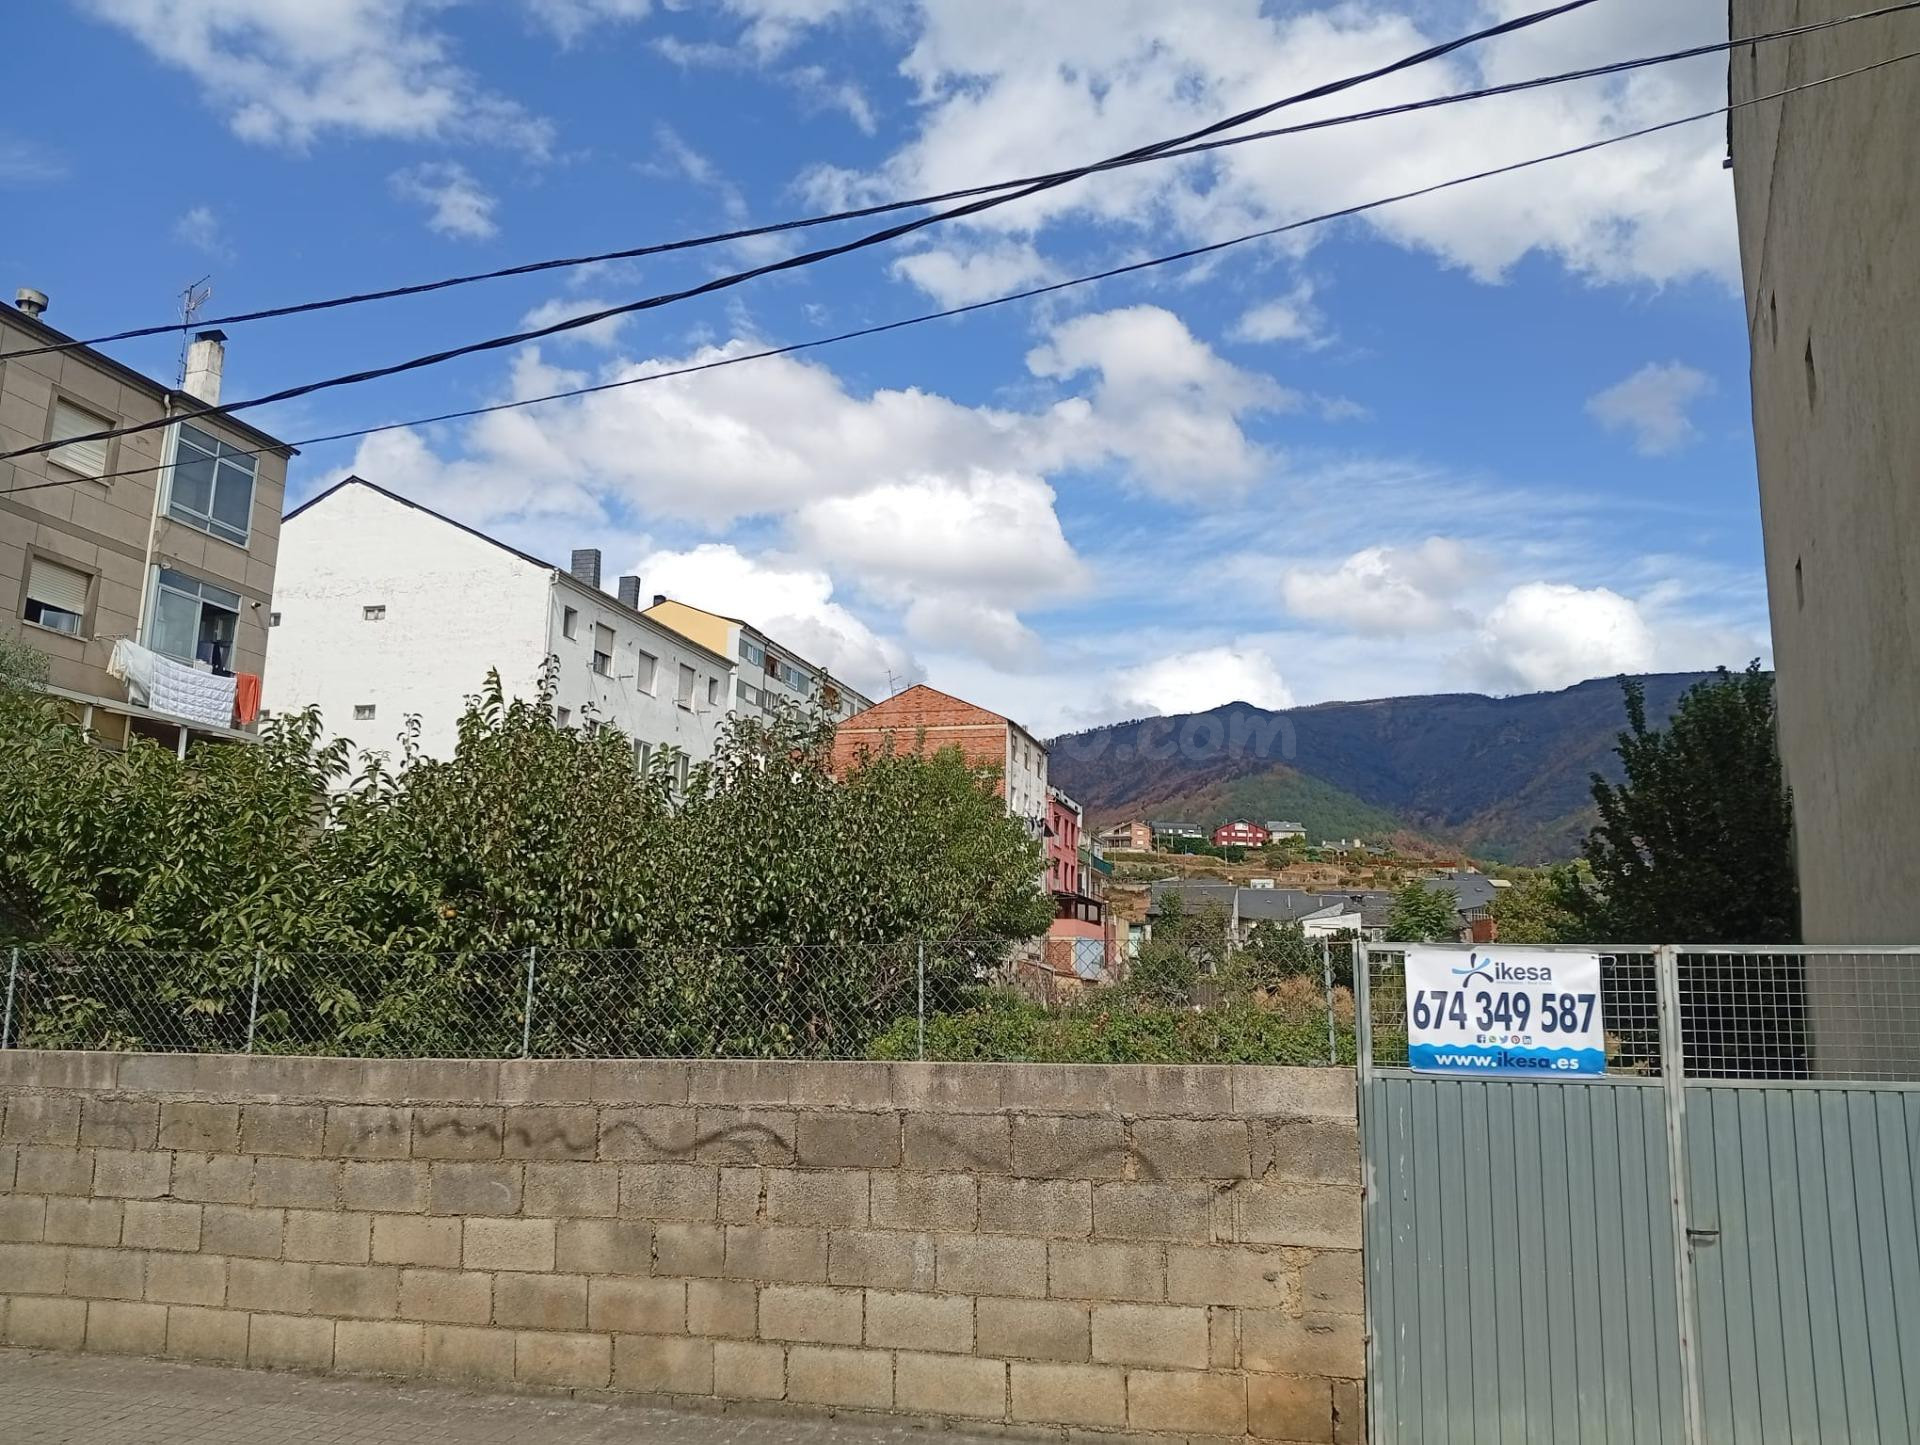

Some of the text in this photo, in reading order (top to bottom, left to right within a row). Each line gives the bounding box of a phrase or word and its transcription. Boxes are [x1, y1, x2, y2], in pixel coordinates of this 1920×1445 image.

[1495, 962, 1552, 981] ikesa
[1413, 990, 1596, 1033] 674 349 587
[1435, 1052, 1579, 1070] www.ikesa.es
